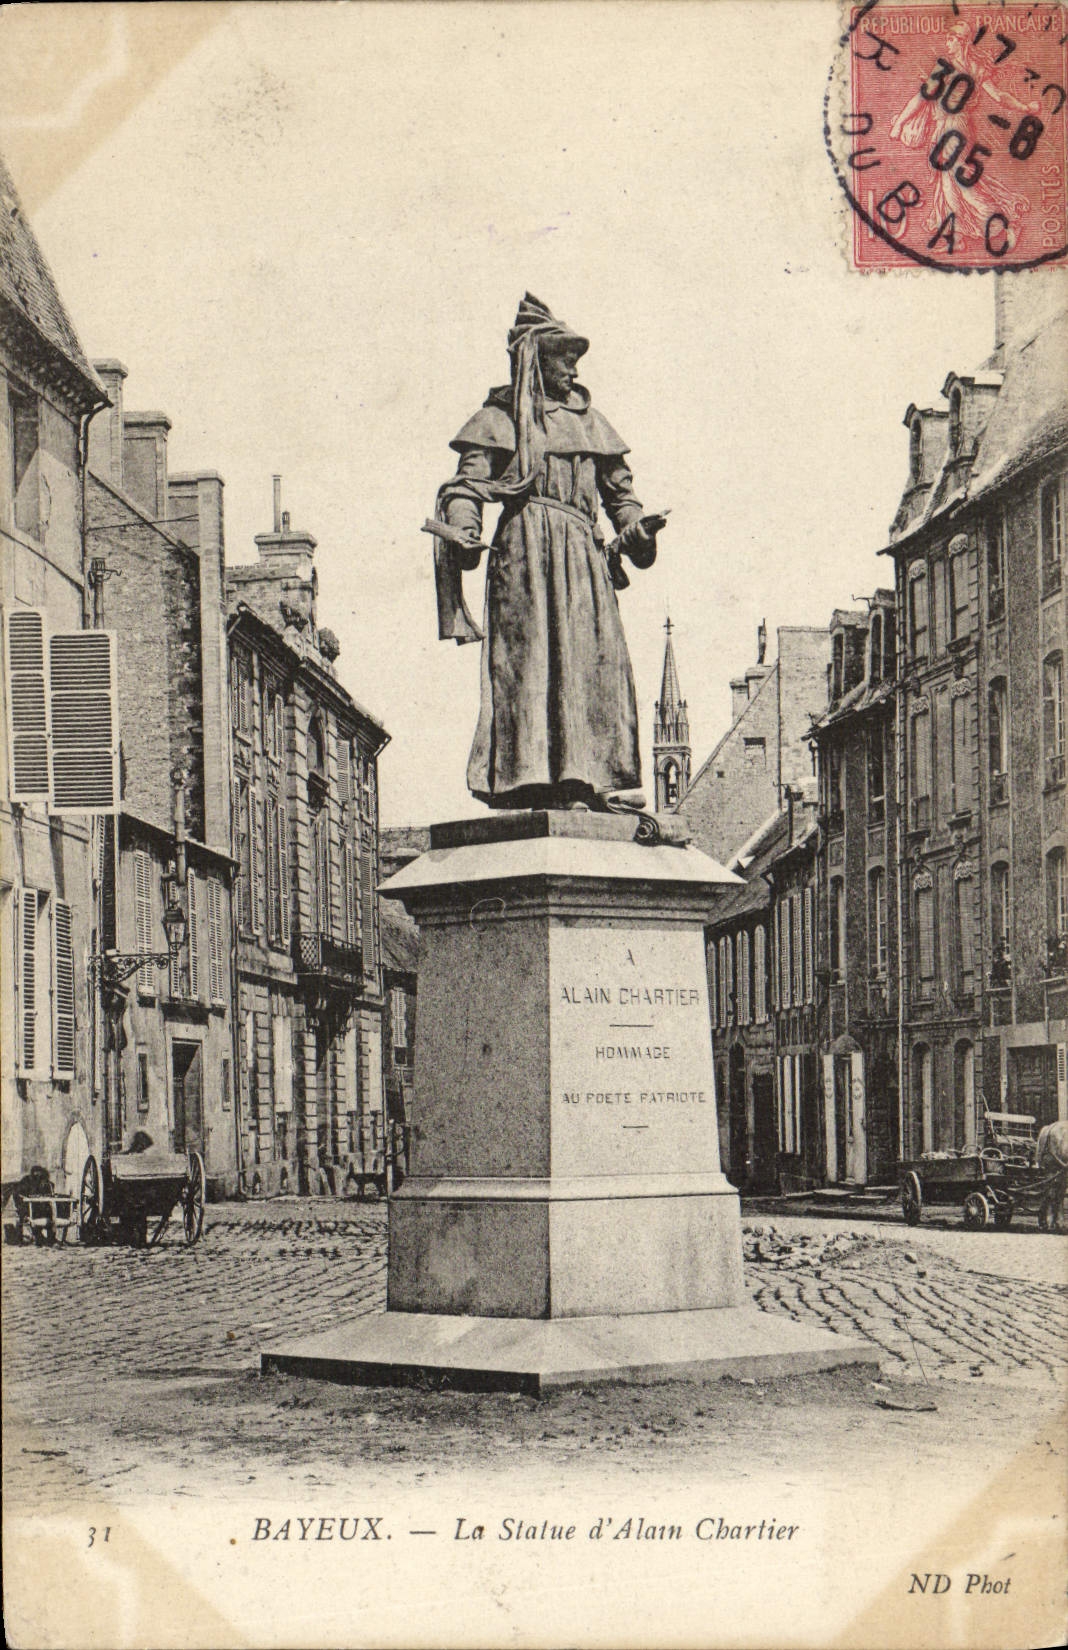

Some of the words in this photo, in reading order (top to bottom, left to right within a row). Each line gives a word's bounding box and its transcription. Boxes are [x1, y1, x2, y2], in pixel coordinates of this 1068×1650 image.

[919, 57, 976, 115] 30
[928, 129, 993, 189] 05
[874, 180, 1010, 258] BAC
[1042, 164, 1061, 248] POSTES
[561, 987, 612, 1004] ALAIN
[619, 987, 701, 1006] CHARTIER
[595, 1045, 672, 1060] HOMMAGE
[562, 1092, 581, 1104] AU
[639, 1090, 707, 1104] PATRIOTE
